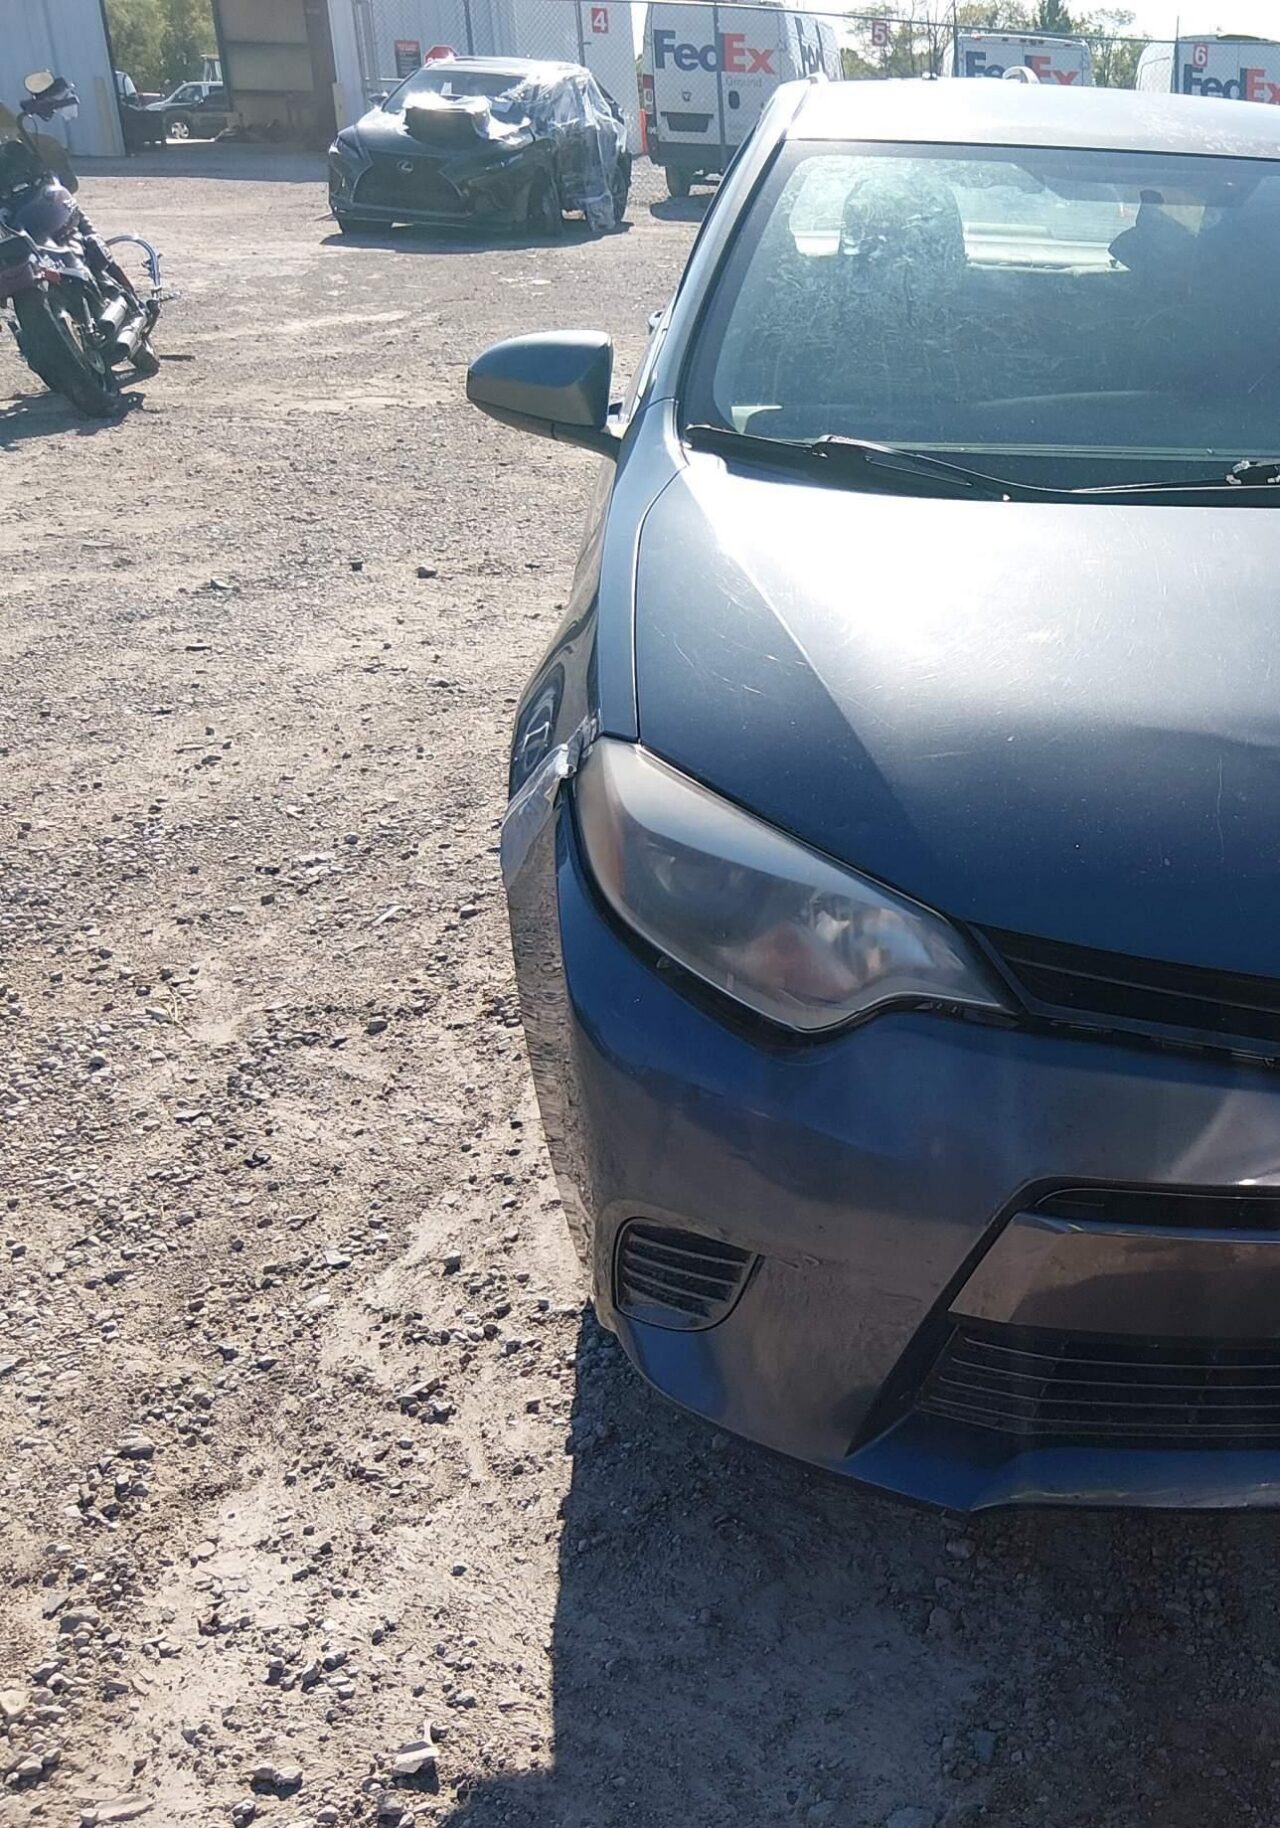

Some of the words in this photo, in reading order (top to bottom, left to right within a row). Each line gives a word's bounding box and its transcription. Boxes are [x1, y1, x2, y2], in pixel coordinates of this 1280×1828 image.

[593, 11, 608, 31] 4
[873, 26, 886, 45] 5
[653, 30, 775, 75] FedEx
[1194, 46, 1207, 65] 6
